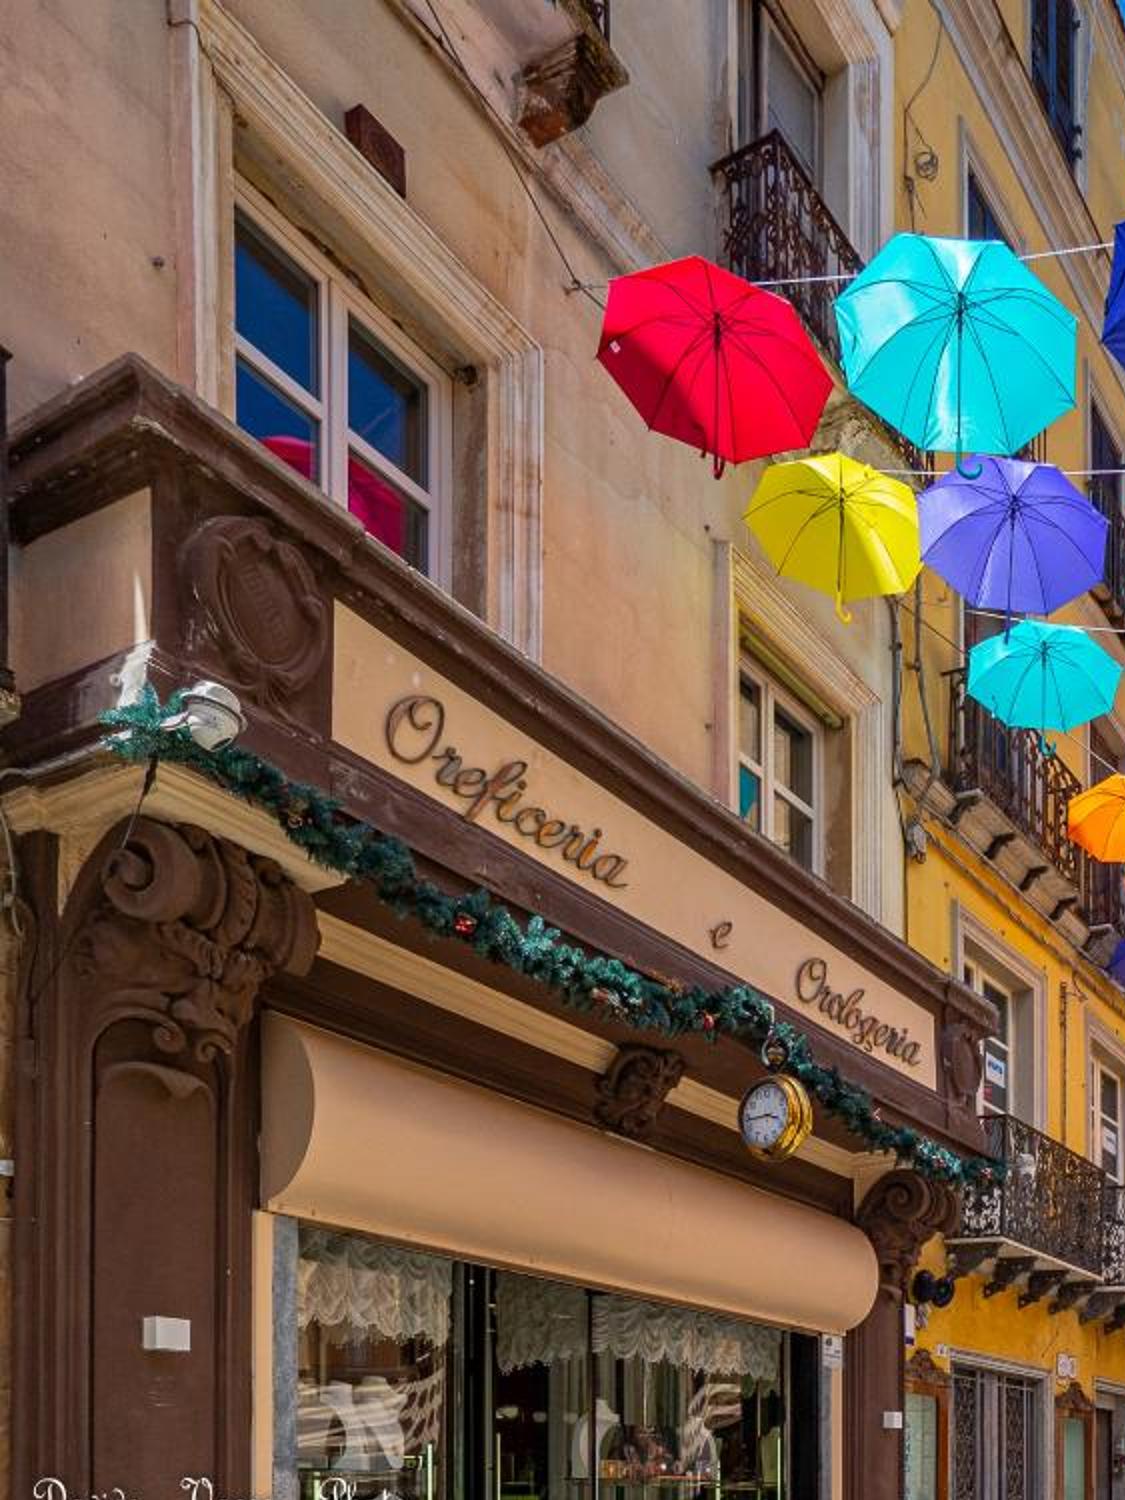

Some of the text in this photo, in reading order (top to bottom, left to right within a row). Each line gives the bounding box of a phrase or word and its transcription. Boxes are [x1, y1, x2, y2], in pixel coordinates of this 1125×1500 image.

[385, 695, 923, 1067] Oreficeria e Orologeria
